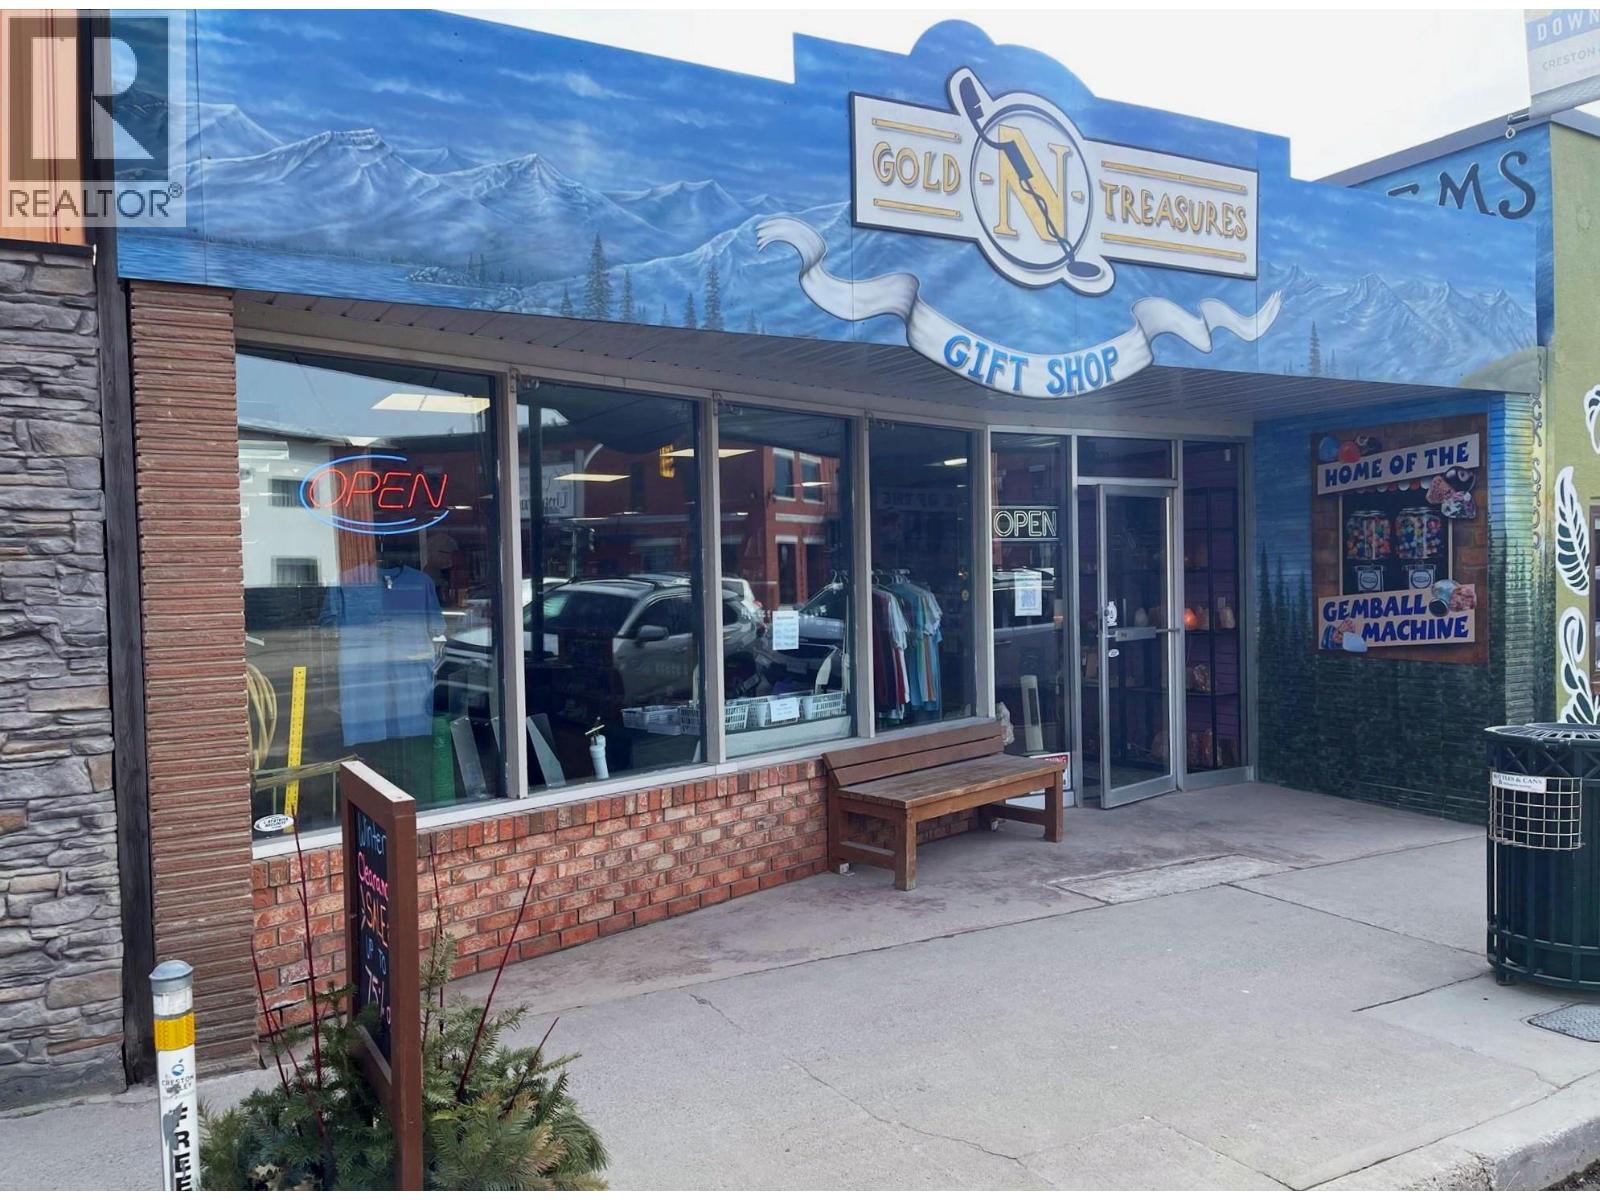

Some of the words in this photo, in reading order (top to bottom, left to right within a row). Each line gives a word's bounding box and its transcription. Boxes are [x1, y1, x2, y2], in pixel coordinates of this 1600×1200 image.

[872, 141, 961, 194] GOLD
[1100, 179, 1248, 240] TREASURES
[944, 335, 1029, 392] GIFT
[1046, 345, 1119, 397] SHOP
[1325, 458, 1383, 487] HOME
[1389, 452, 1418, 475] OF
[1425, 441, 1470, 468] THE
[308, 468, 449, 509] OPEN
[993, 510, 1057, 537] OPEN
[1322, 593, 1428, 623] GEMBALL
[1361, 616, 1469, 643] MACHINE
[357, 812, 388, 855] Winter
